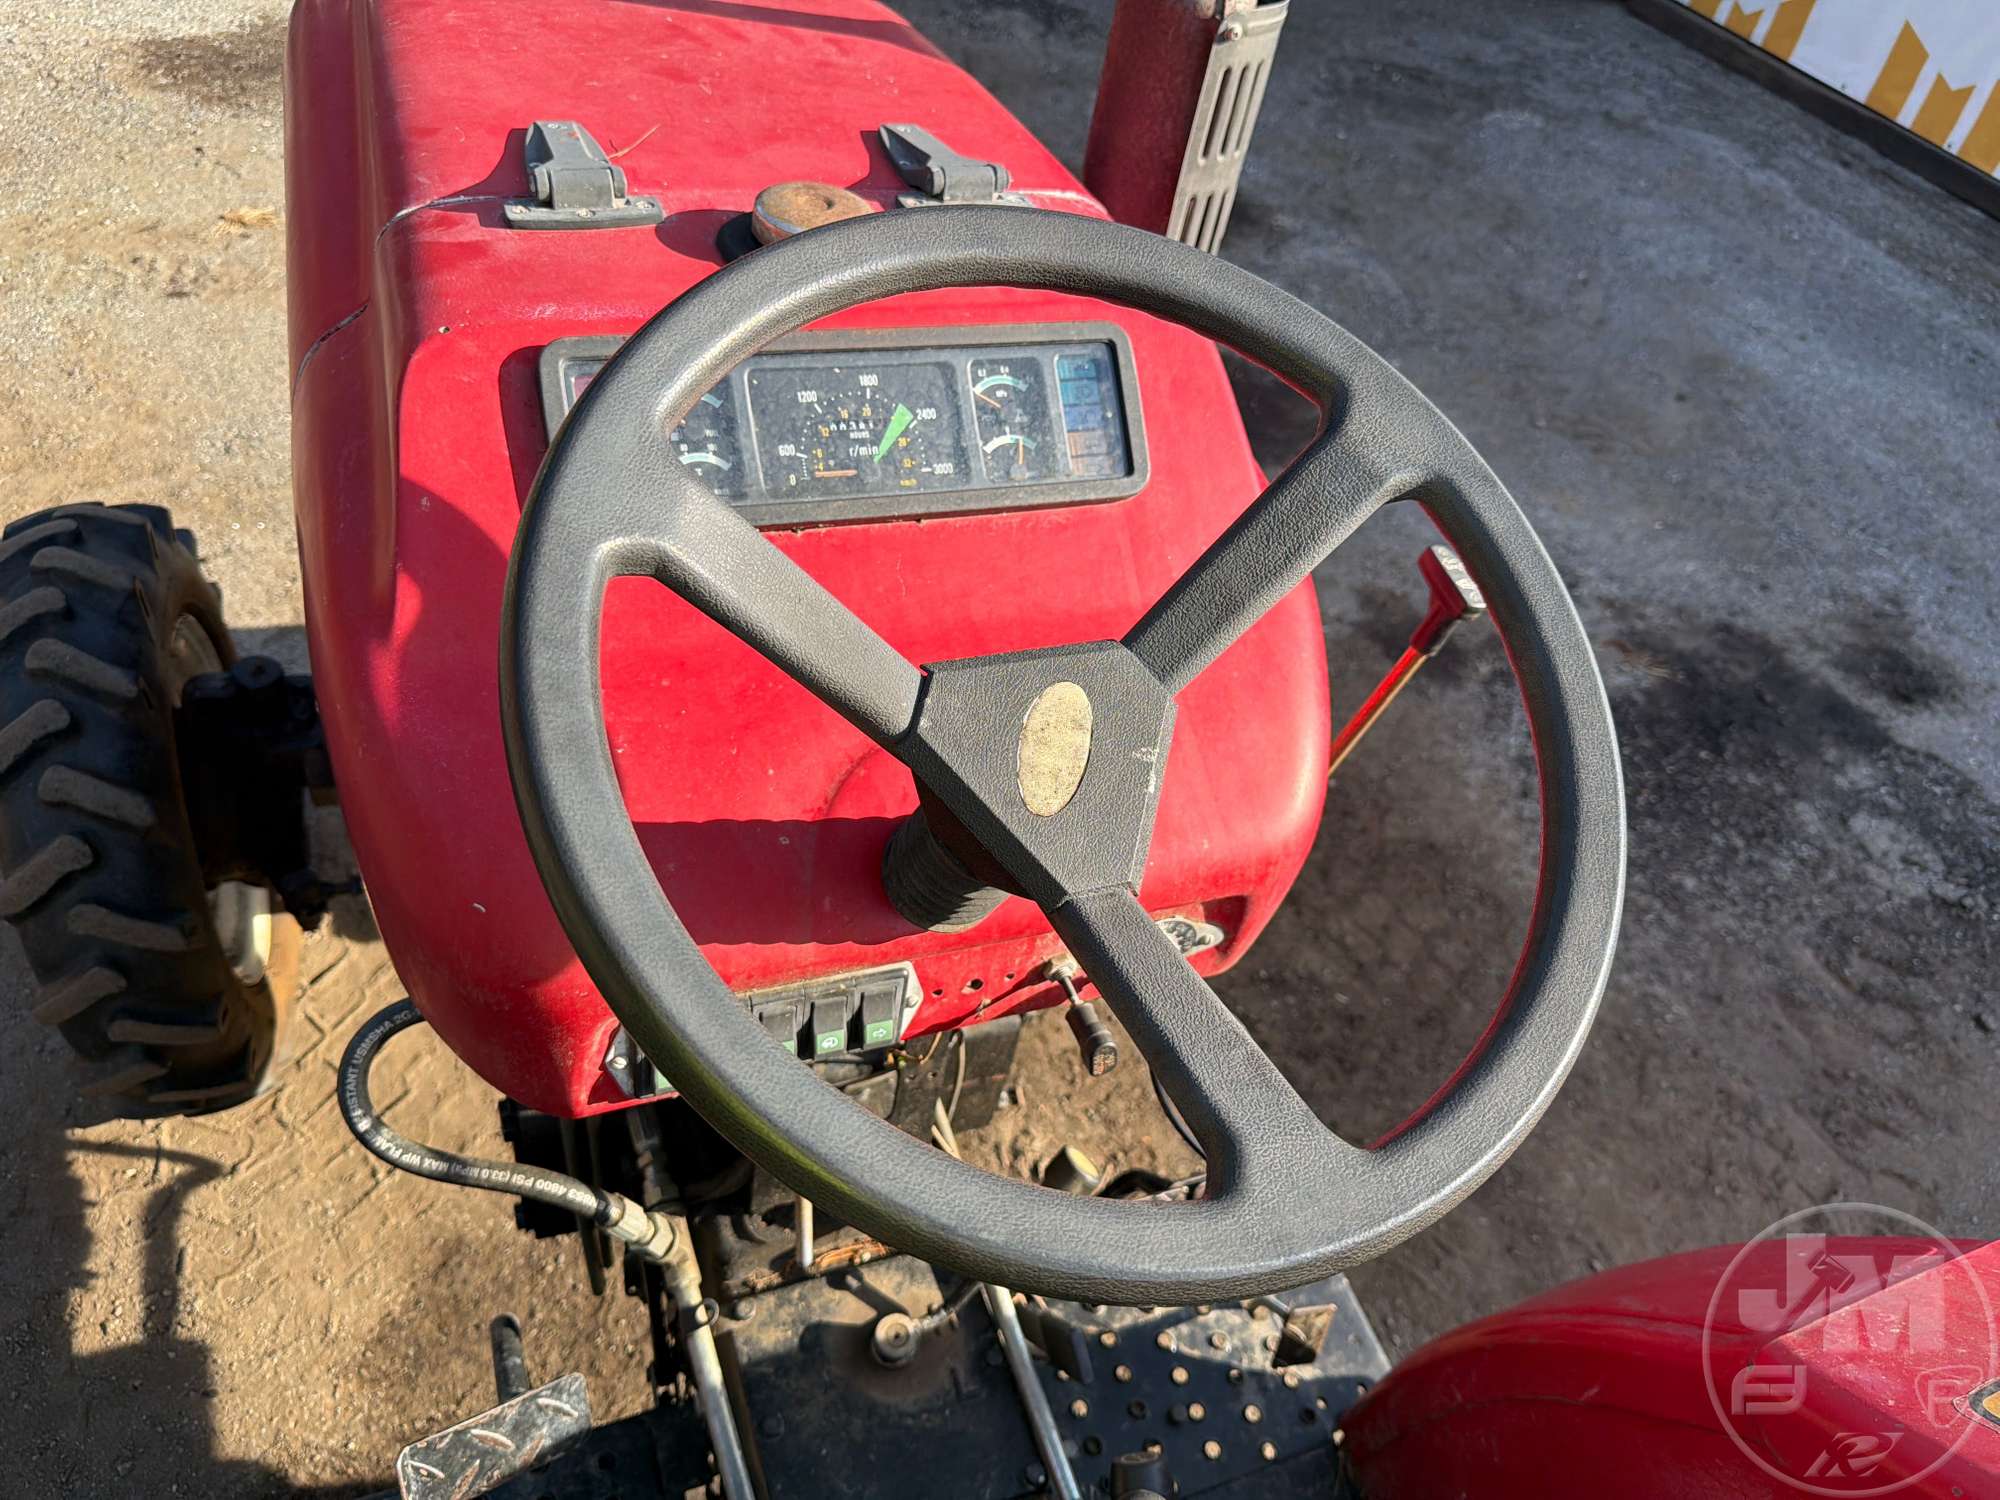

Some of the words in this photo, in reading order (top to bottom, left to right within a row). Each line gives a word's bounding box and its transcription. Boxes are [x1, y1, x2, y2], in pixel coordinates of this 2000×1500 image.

[858, 374, 879, 387] 1800
[797, 390, 818, 403] 1200
[916, 407, 937, 420] 2400
[778, 444, 796, 457] 600
[848, 444, 880, 458] r/min
[932, 462, 954, 475] 3000
[788, 473, 797, 487] 0
[401, 1152, 421, 1168] WP
[423, 1157, 450, 1174] MAX
[480, 1167, 511, 1182] (33.0
[511, 1172, 535, 1187] PSI
[535, 1177, 567, 1197] 4800
